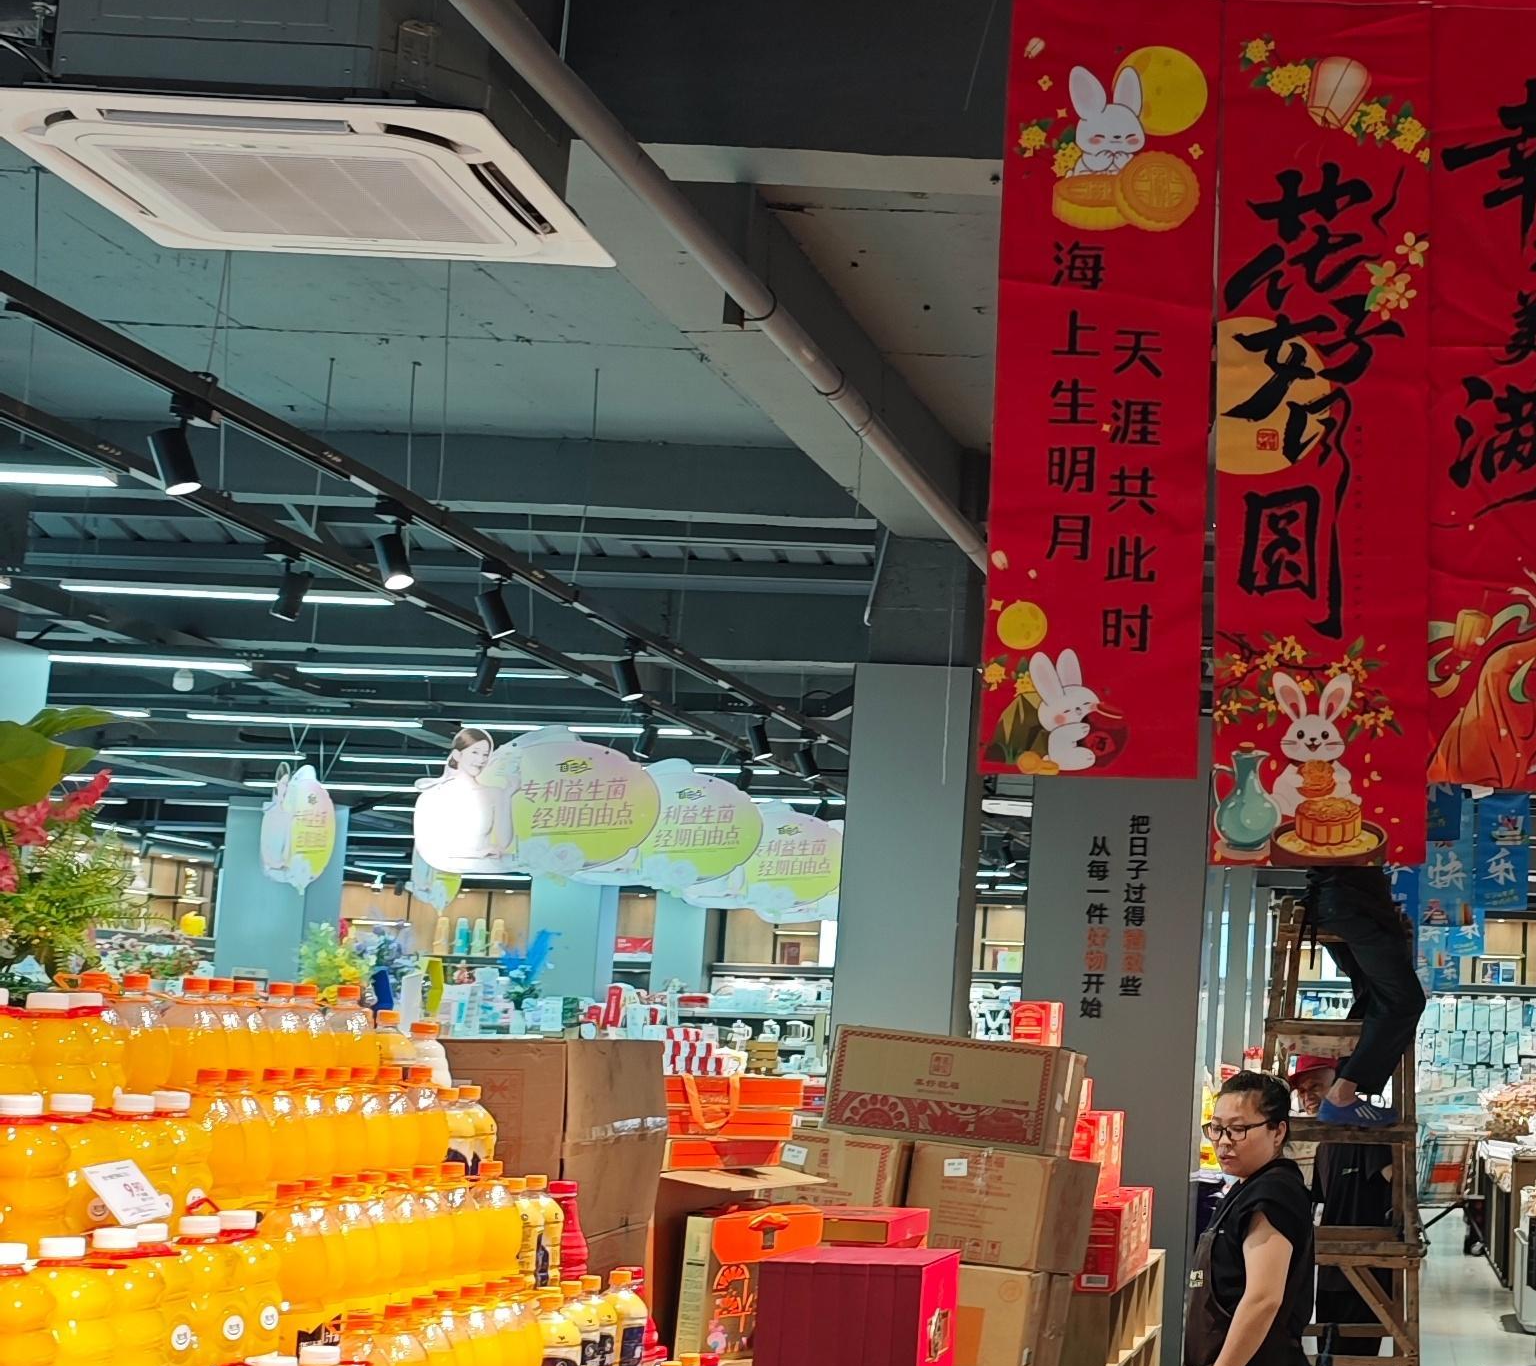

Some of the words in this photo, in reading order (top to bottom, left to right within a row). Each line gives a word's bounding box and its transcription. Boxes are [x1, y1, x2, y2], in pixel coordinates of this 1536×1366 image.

[1047, 240, 1106, 563] 海上生明月
[1099, 328, 1164, 654] 天涯共此时
[520, 778, 628, 804] 专利益生菌
[531, 803, 635, 829] 经期自由点
[654, 826, 741, 848] 经期自由点
[758, 859, 832, 876] 经期自由点
[1427, 850, 1468, 891] 快
[1481, 847, 1518, 885] 乐
[1079, 835, 1111, 1019] 从每一件好物开始
